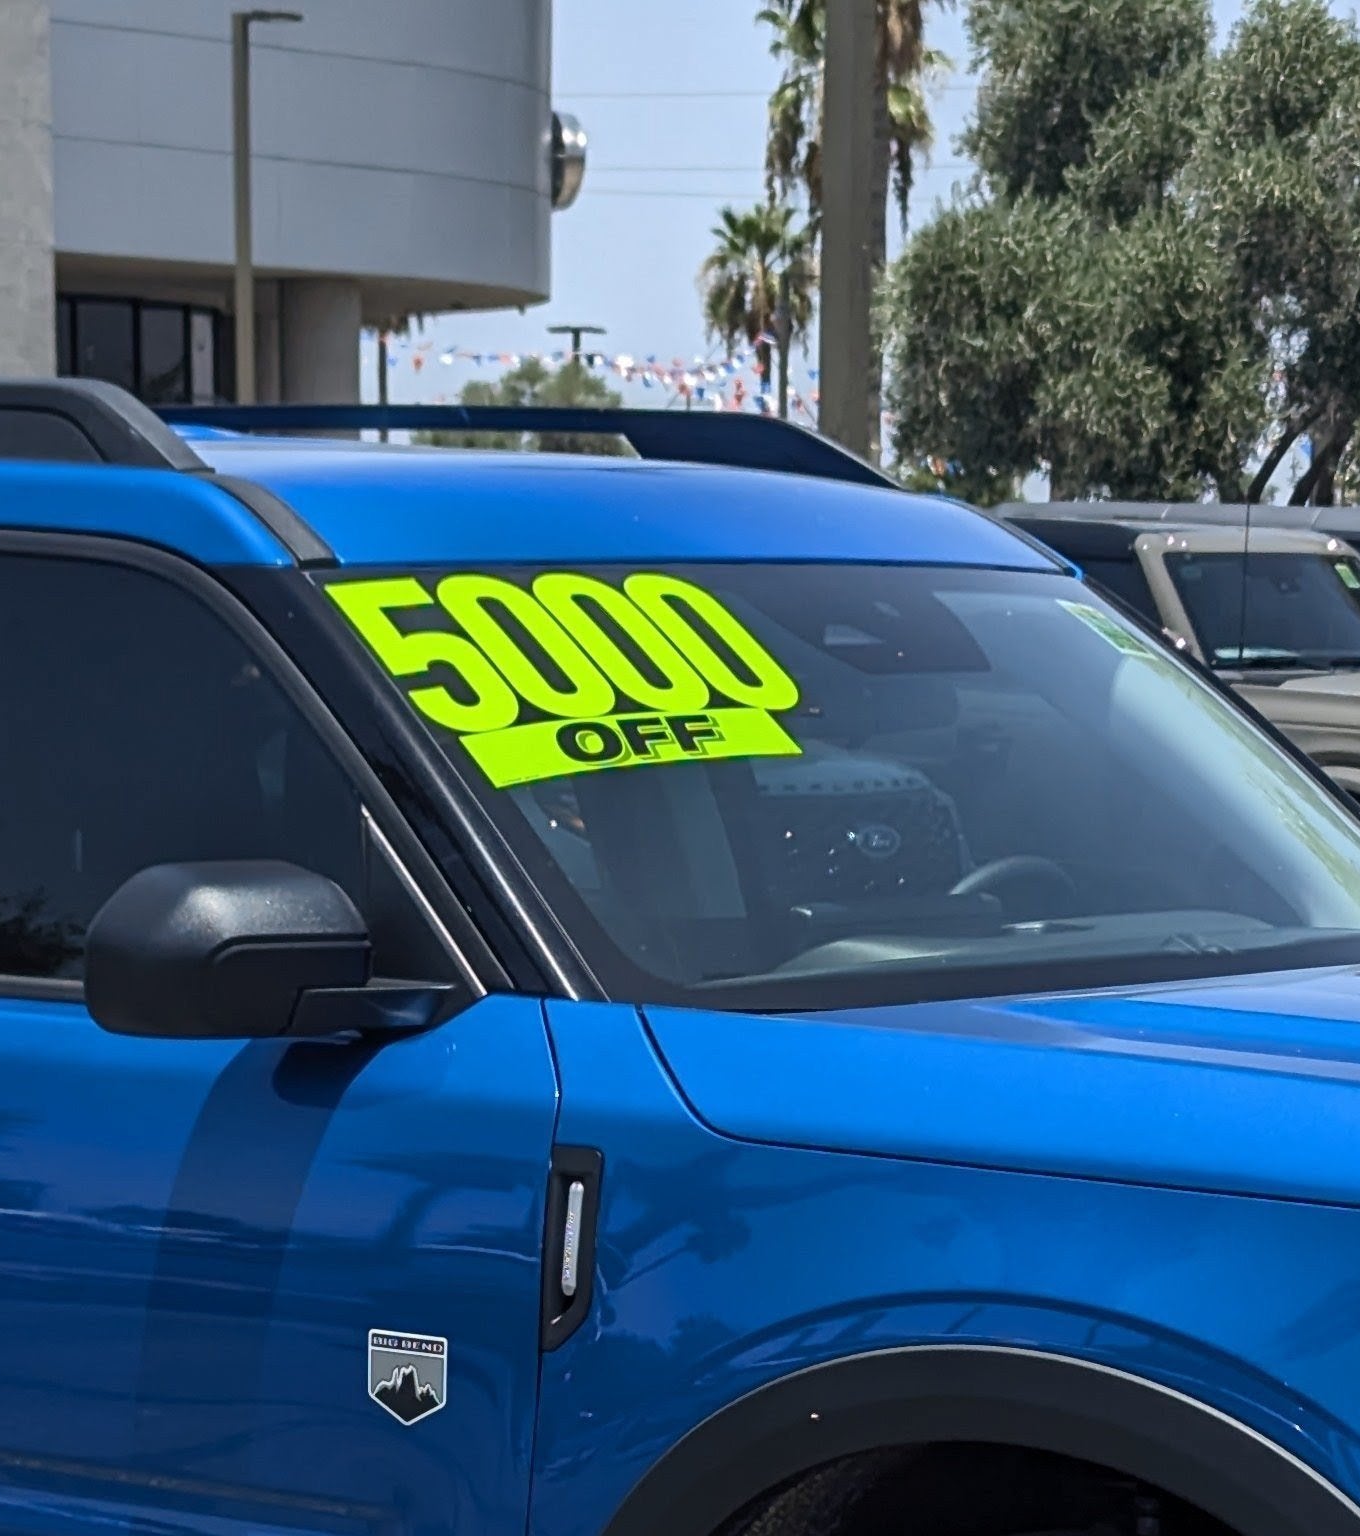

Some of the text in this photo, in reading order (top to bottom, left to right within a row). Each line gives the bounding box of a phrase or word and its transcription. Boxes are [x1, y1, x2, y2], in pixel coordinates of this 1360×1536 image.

[324, 573, 799, 732] 5000
[555, 714, 725, 766] OFF
[373, 1336, 443, 1353] BIG BEND
